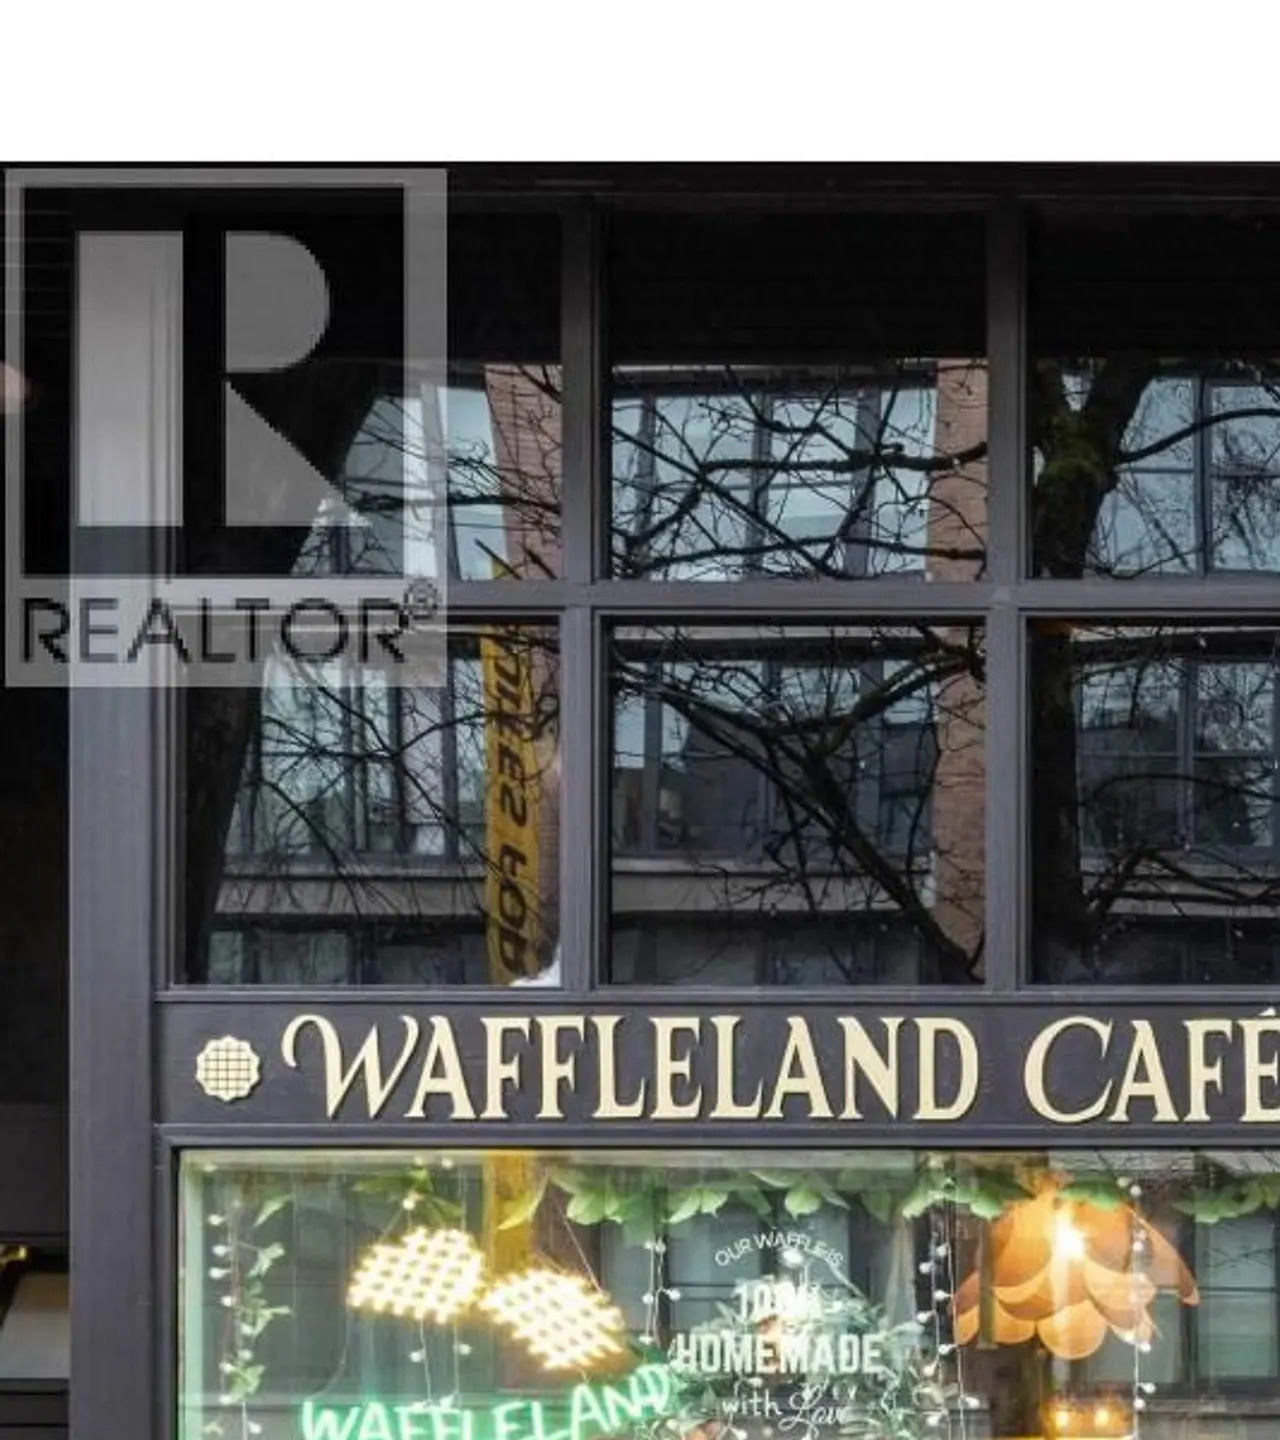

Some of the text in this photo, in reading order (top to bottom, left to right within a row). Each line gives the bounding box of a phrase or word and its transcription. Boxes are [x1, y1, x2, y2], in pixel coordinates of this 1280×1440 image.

[282, 1014, 979, 1120] WAFFLELAND
[714, 1238, 754, 1267] OUR
[675, 1332, 883, 1374] HOMEMADE
